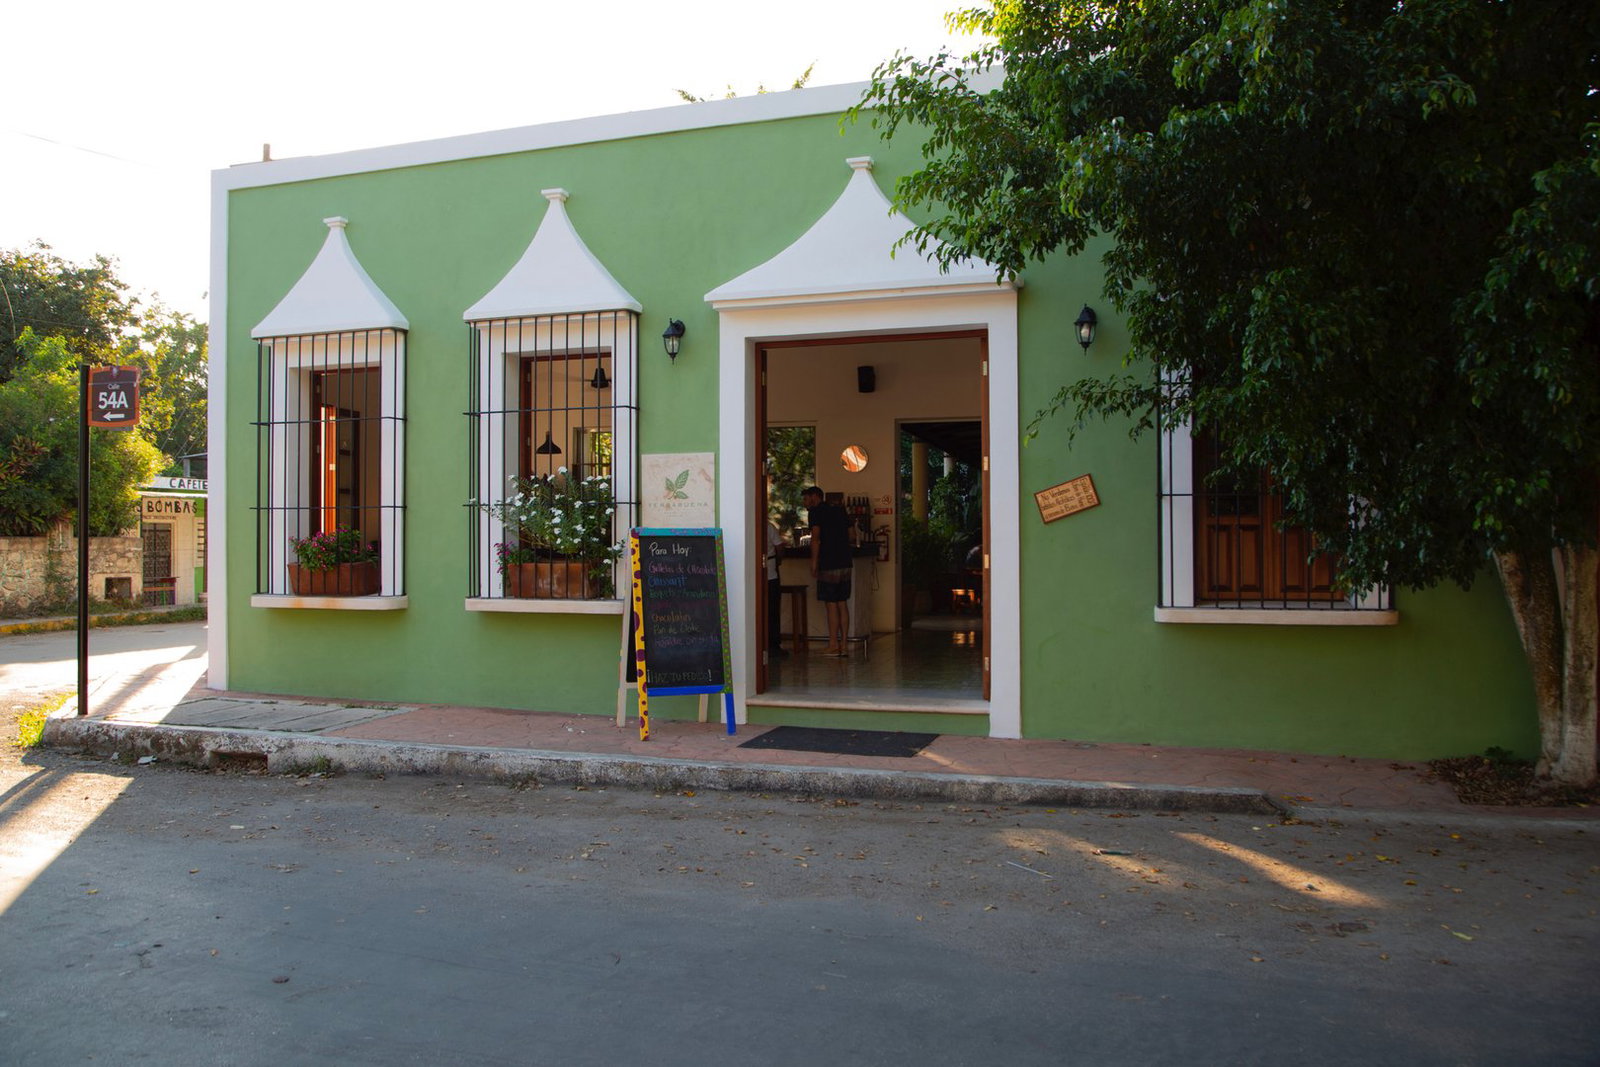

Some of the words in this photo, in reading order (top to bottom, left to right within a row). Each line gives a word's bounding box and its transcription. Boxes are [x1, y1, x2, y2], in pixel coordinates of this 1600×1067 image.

[98, 391, 129, 409] 54A
[147, 500, 198, 514] BOMBAS
[649, 541, 668, 557] Para
